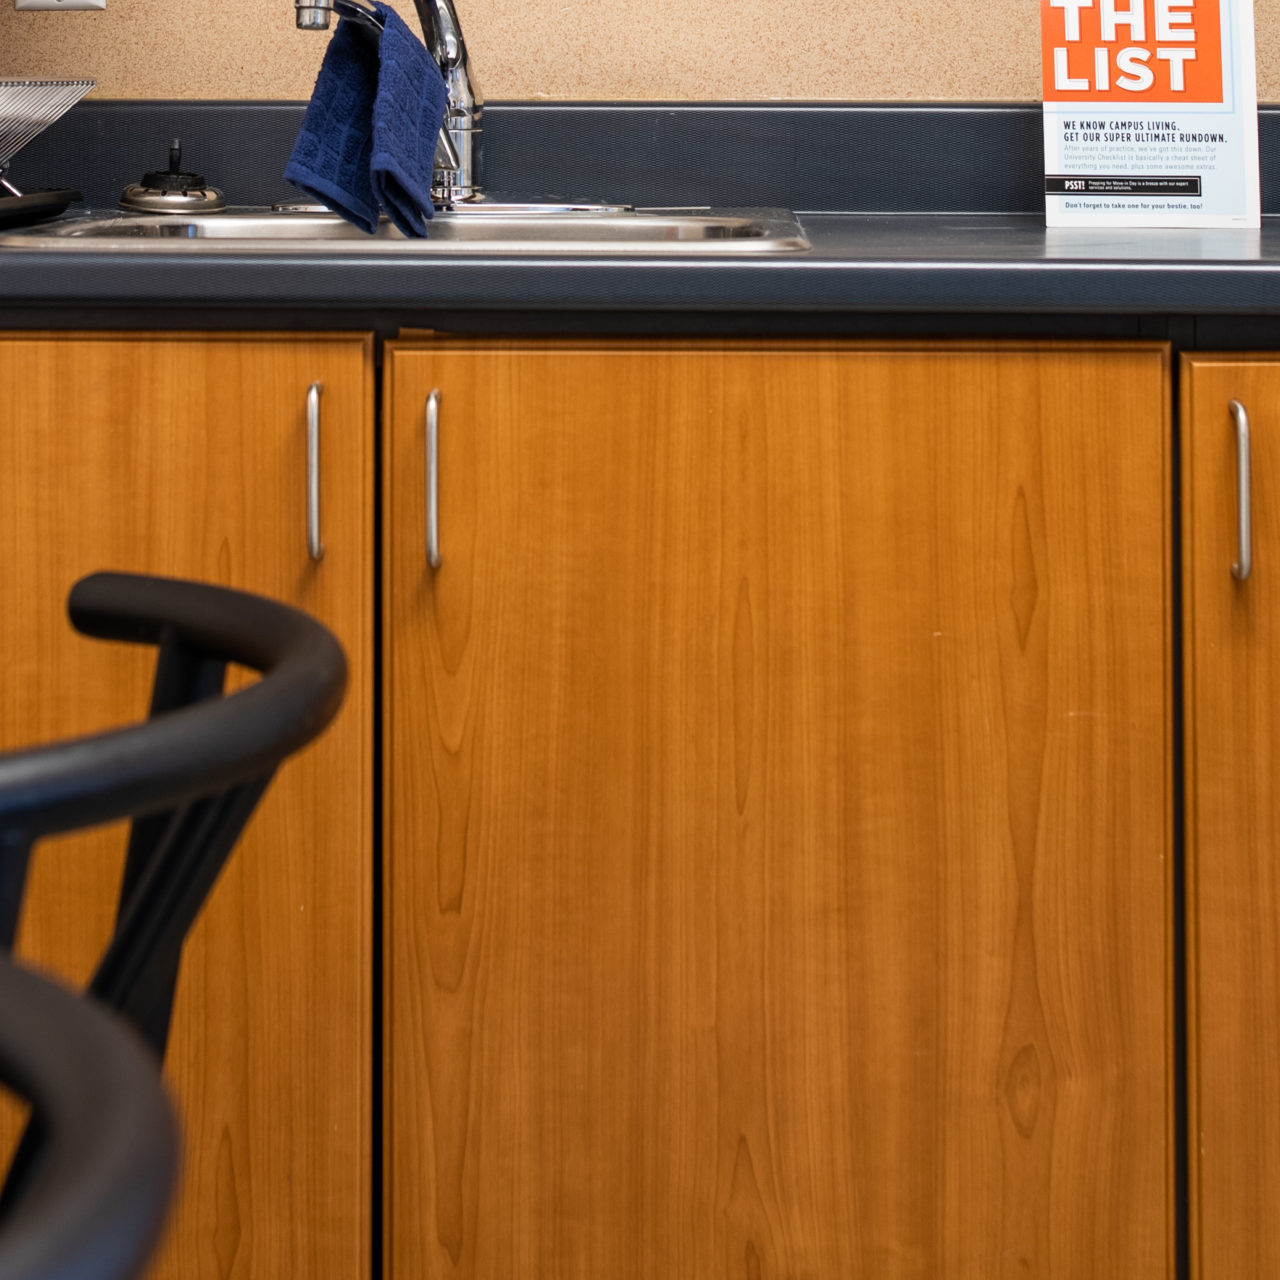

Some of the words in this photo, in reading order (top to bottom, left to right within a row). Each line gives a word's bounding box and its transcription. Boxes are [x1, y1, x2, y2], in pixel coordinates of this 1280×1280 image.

[1053, 47, 1196, 92] LIST
[1064, 121, 1076, 130] WE
[1080, 121, 1106, 130] KNOW
[1109, 121, 1144, 130] CAMPUS
[1148, 121, 1180, 131] LIVING.
[1064, 132, 1079, 142] GET
[1083, 132, 1100, 142] OUR
[1104, 132, 1131, 142] SUPER
[1135, 133, 1176, 142] ULTIMATE
[1180, 133, 1227, 143] RUNDOWN.
[1136, 154, 1163, 162] basically
[1064, 180, 1085, 190] PSST!
[1084, 202, 1102, 210] forget
